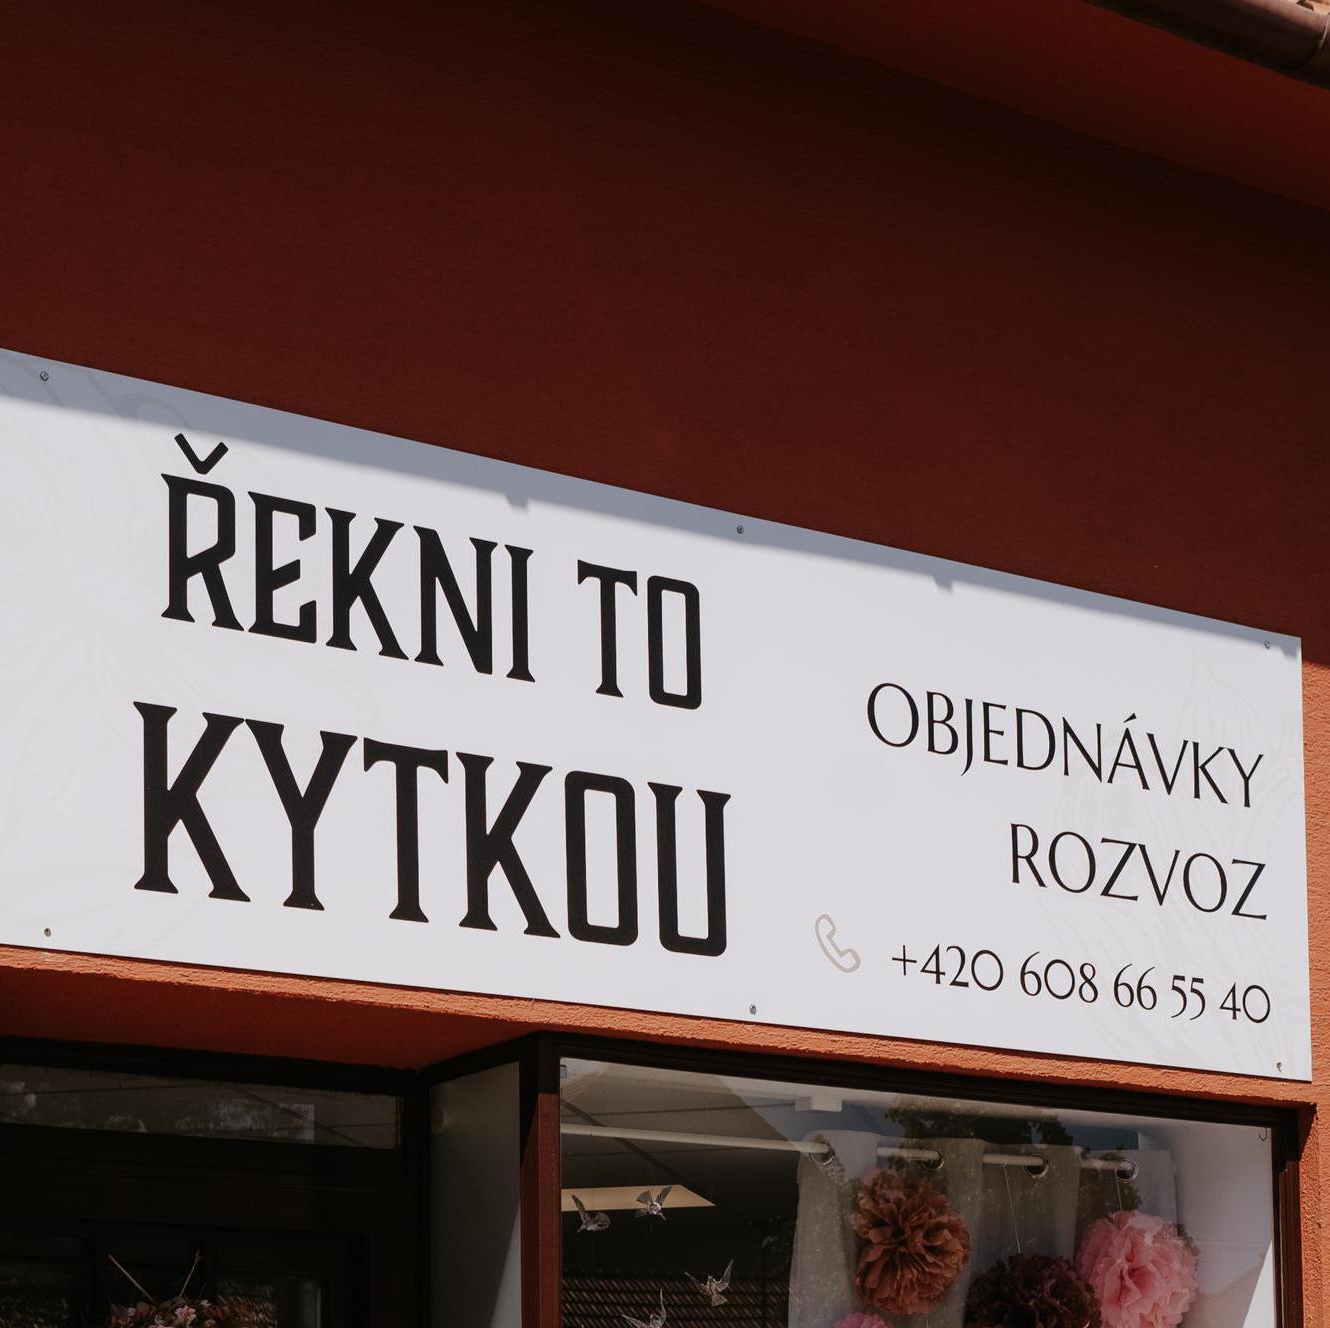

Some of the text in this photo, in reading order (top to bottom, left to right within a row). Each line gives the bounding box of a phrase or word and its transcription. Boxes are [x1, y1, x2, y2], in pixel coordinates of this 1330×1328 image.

[160, 432, 702, 710] ŘEKNI TO
[866, 682, 1264, 808] OBJEDNÁVKY
[133, 700, 731, 957] KYTKOU
[1010, 822, 1268, 921] ROZVOZ
[891, 943, 1271, 1024] +420 608 66 55 40
